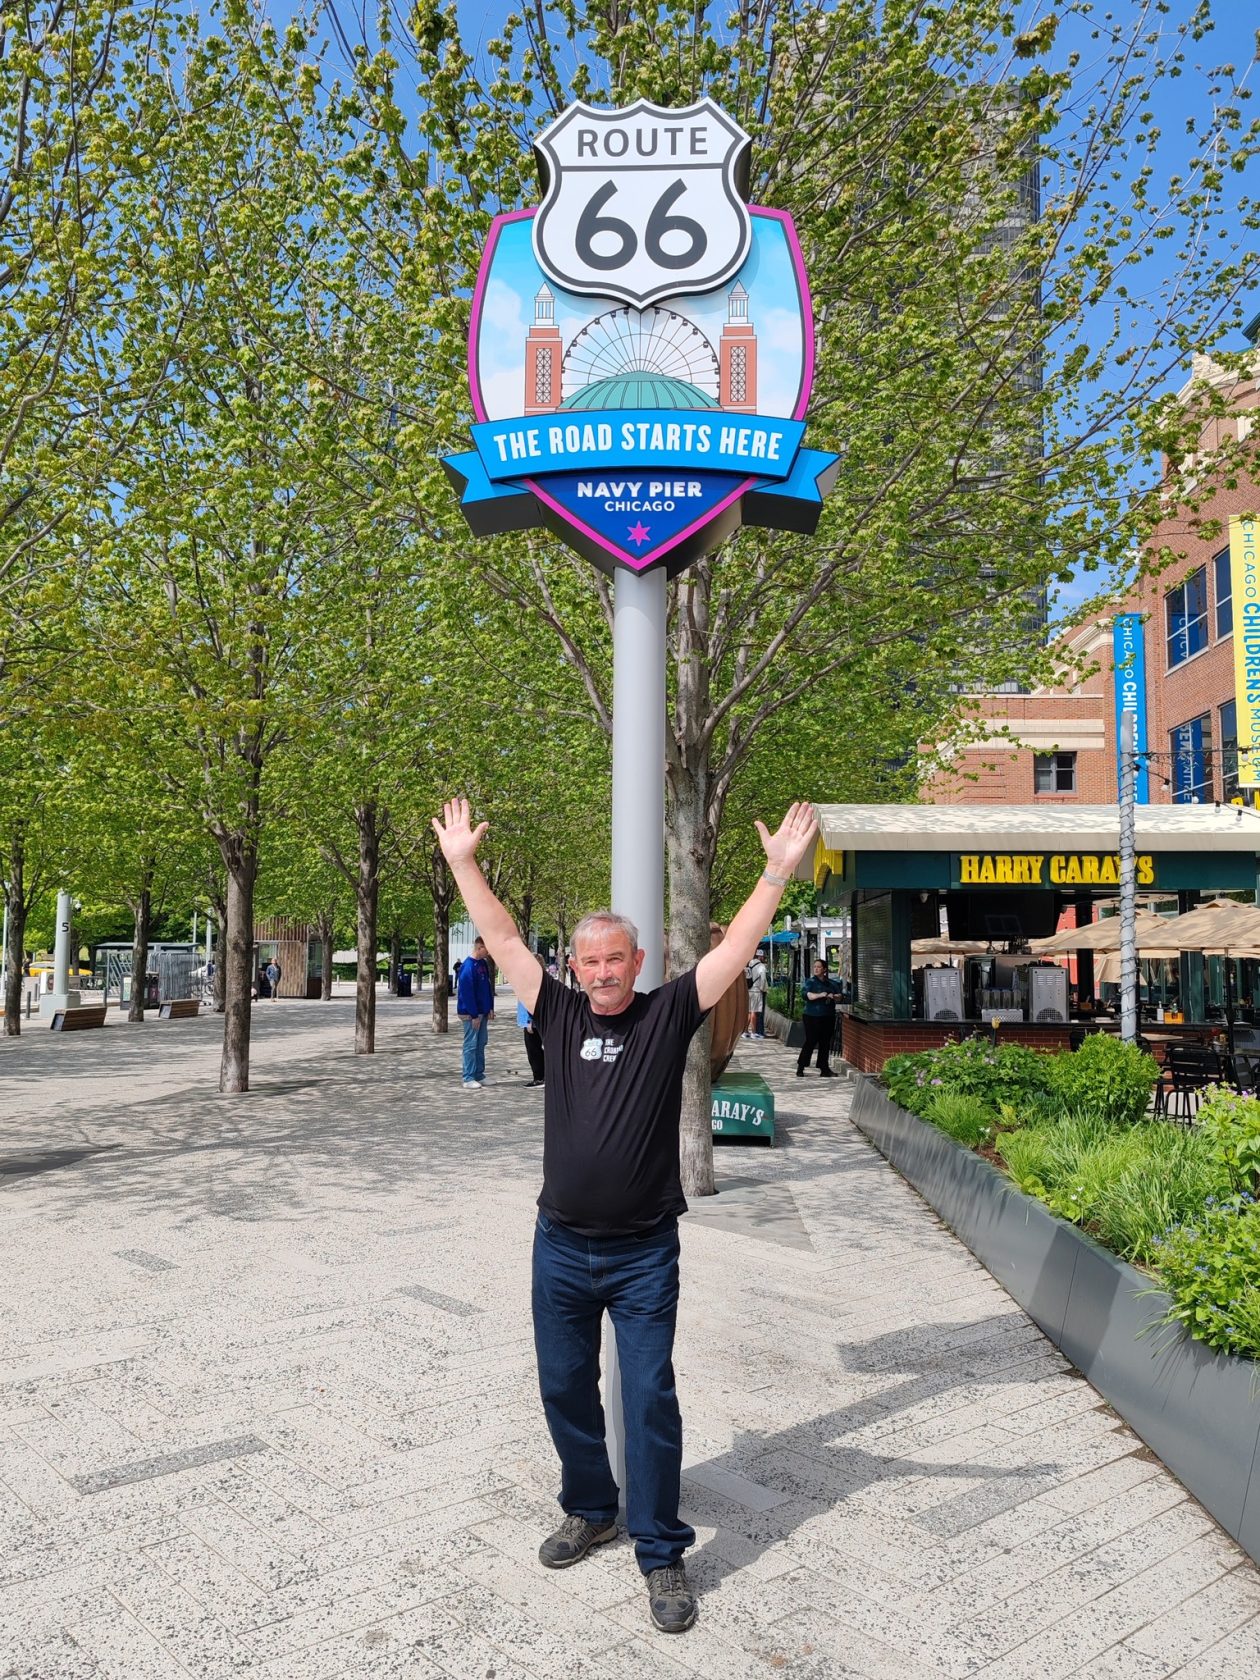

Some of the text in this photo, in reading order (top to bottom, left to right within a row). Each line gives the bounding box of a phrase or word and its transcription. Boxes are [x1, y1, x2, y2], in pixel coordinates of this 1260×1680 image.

[577, 127, 708, 158] ROUTE
[575, 178, 708, 271] 66
[493, 422, 783, 461] THE ROAD STARTS HERE
[577, 481, 702, 498] NAVY PIER
[604, 501, 675, 512] CHICAGO
[1242, 519, 1256, 598] CHICAGO
[960, 855, 1044, 884] HARRY
[61, 922, 70, 932] 5
[585, 1047, 597, 1057] 66
